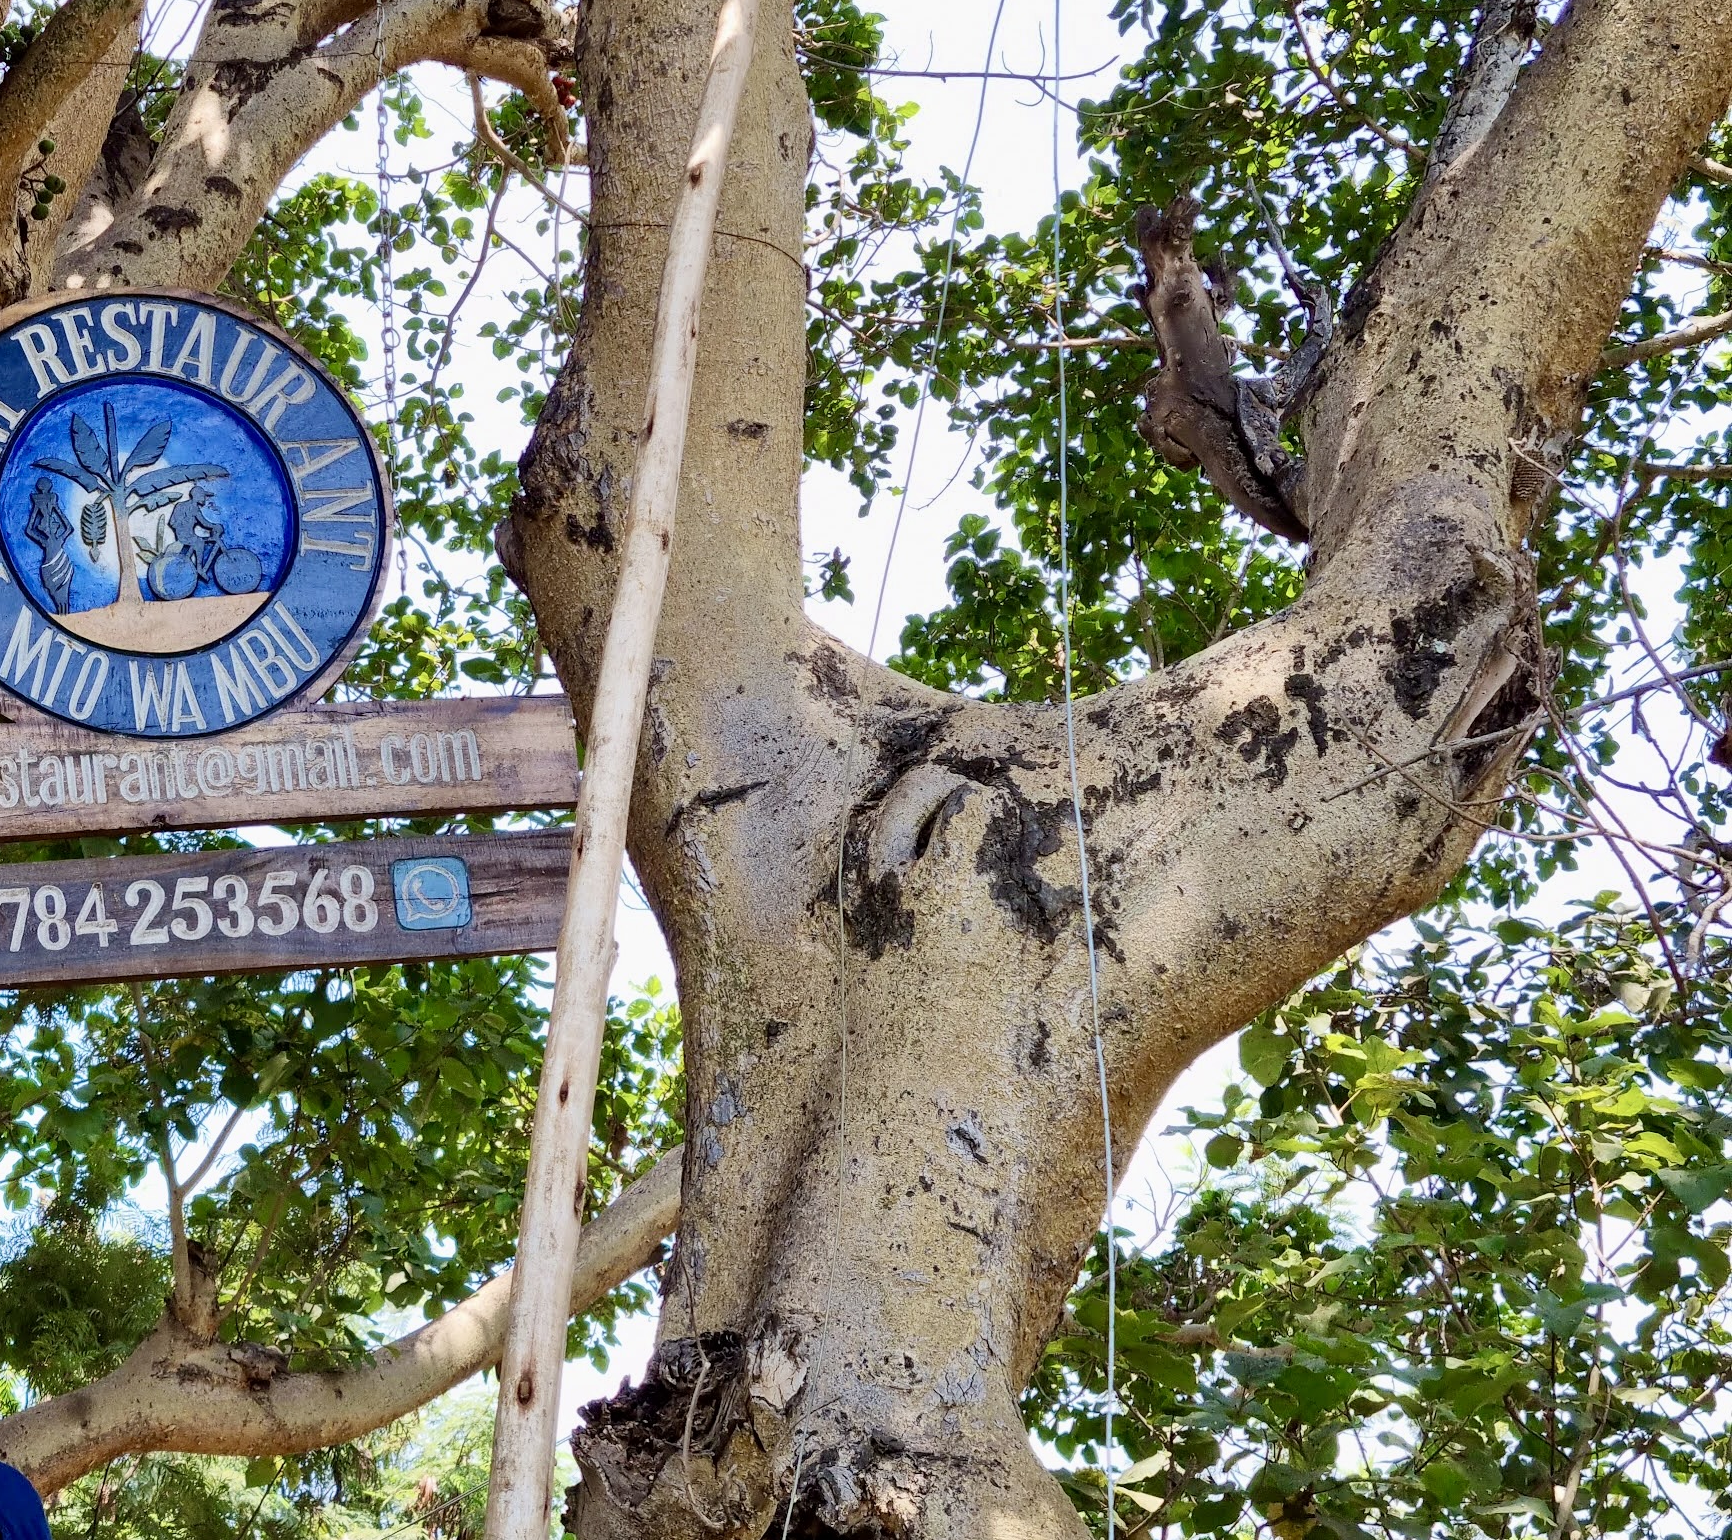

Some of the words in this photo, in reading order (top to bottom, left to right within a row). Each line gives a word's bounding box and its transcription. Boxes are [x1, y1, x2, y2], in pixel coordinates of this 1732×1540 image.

[11, 301, 378, 572] RESTAURANT
[0, 604, 110, 721] MTO
[128, 660, 207, 733] WA
[209, 600, 321, 723] MBU
